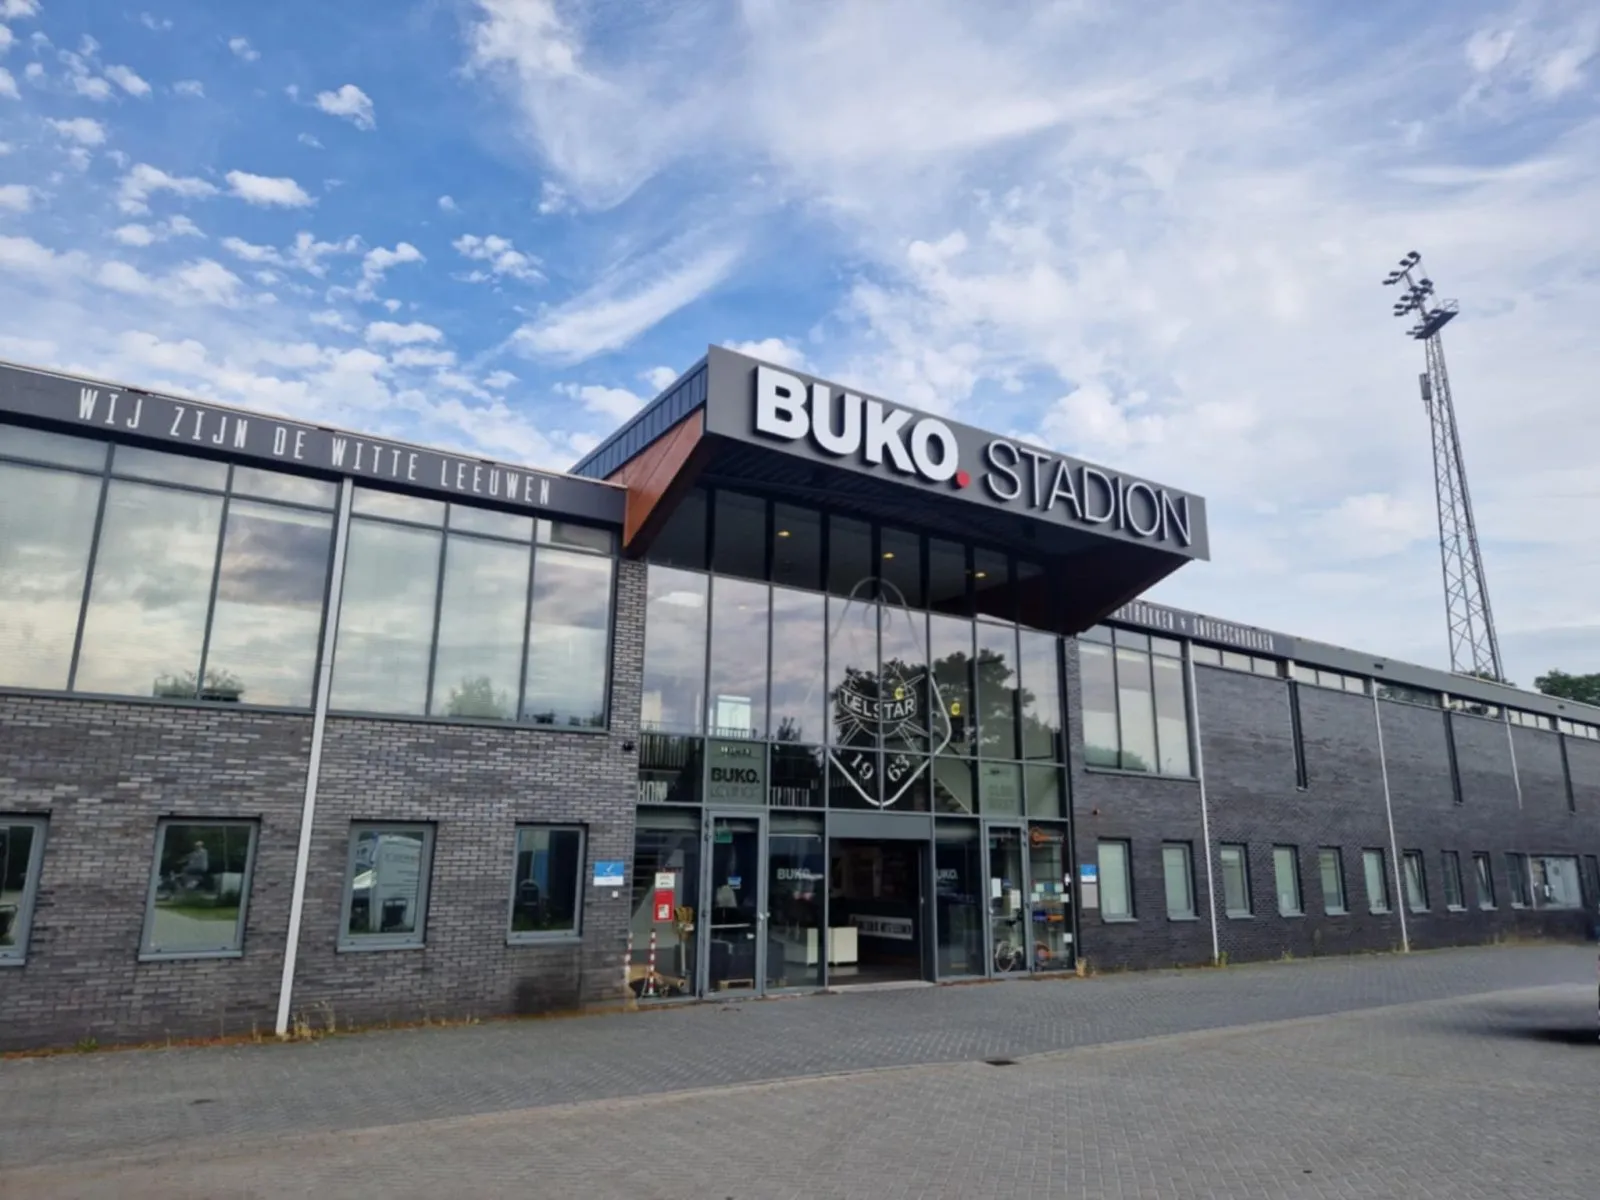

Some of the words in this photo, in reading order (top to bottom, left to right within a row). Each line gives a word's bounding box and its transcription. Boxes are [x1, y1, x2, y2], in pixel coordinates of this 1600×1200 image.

[78, 387, 142, 430] WIJ
[169, 406, 248, 449] ZIJN
[272, 426, 307, 461] DE
[331, 436, 420, 481] WITTE
[439, 459, 552, 506] LEEUWEN
[754, 366, 971, 489] BUKO.
[985, 438, 1193, 547] STADION
[840, 688, 914, 719] TELSTAR
